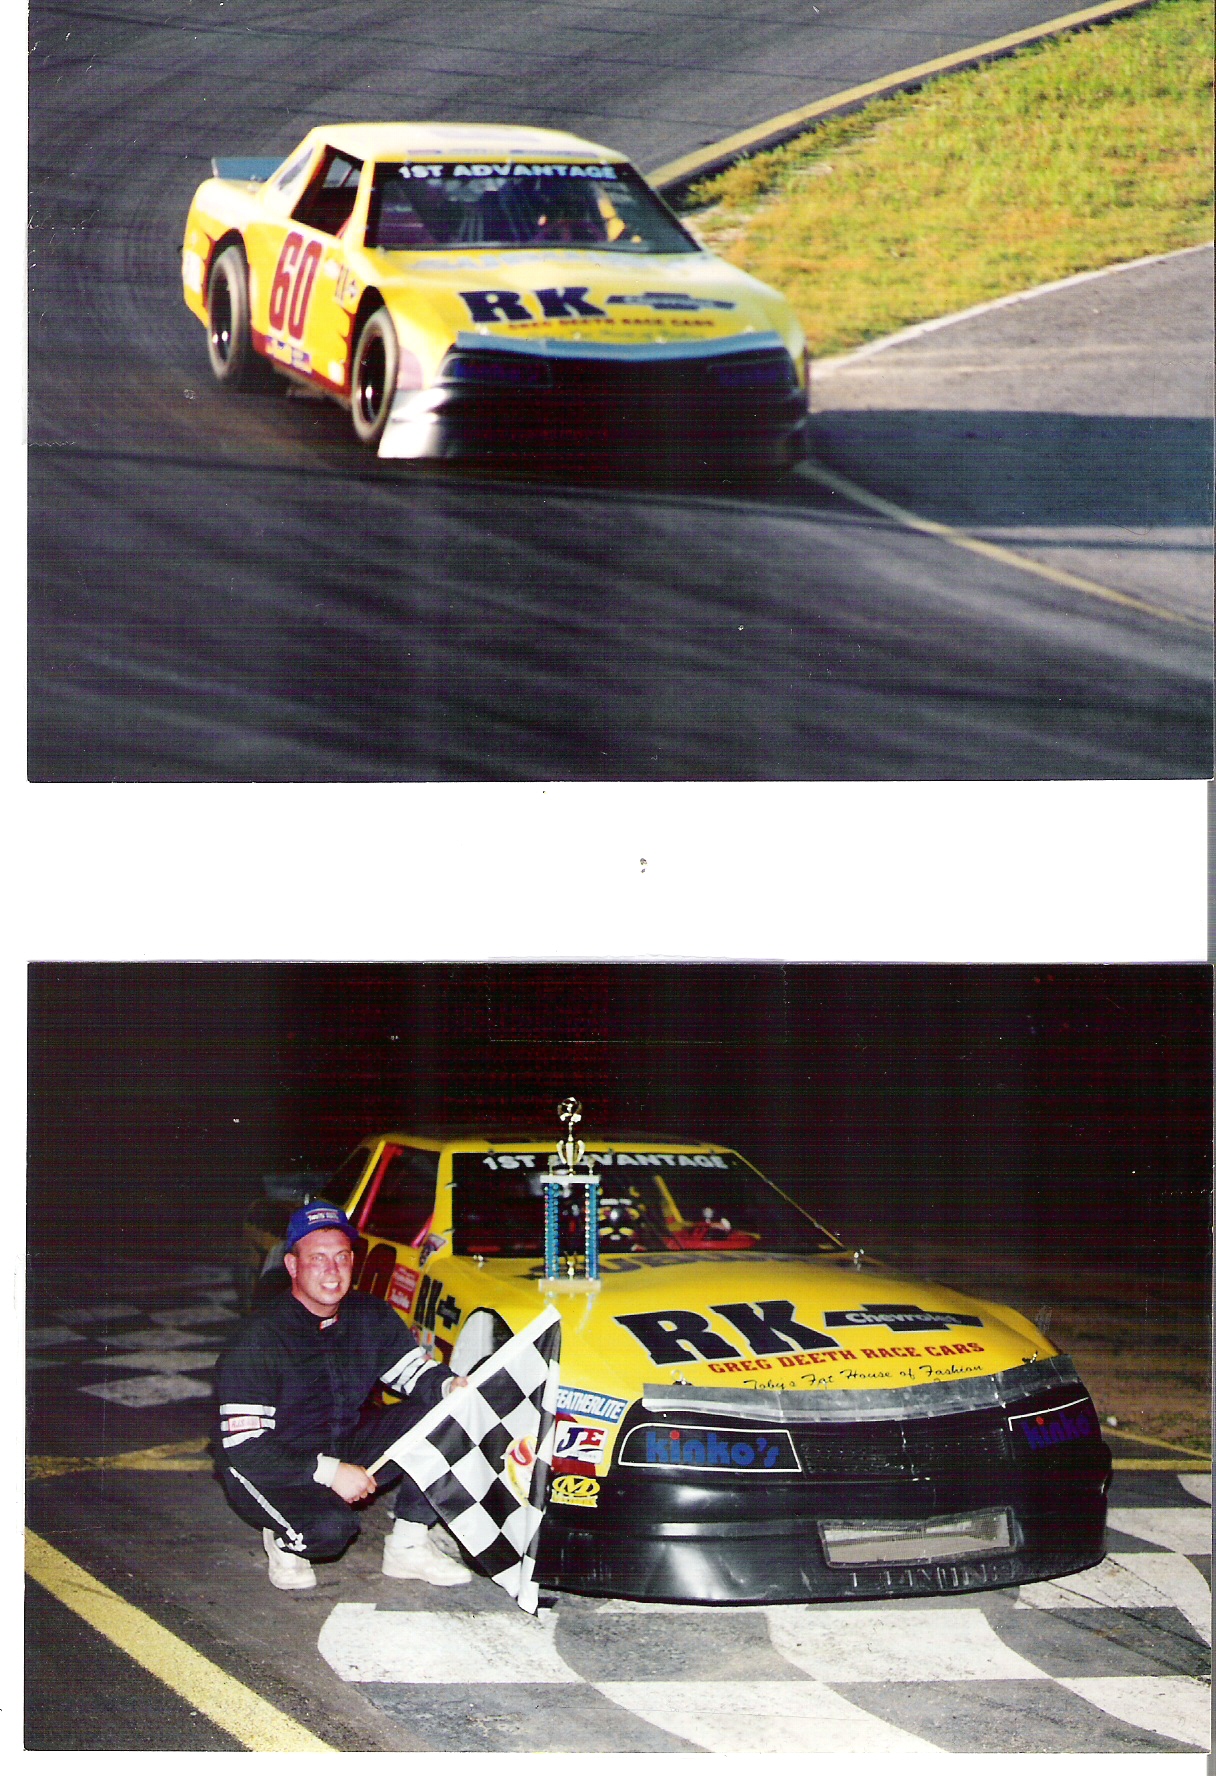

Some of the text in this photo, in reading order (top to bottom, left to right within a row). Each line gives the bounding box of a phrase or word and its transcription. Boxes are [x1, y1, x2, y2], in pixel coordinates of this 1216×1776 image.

[398, 164, 617, 180] 1ST ADVANTAGE
[268, 231, 322, 340] 60
[459, 287, 607, 323] RK
[483, 1156, 535, 1169] 1ST
[615, 1300, 840, 1366] RK
[845, 1312, 962, 1326] Chevrolet
[708, 1342, 985, 1374] GREG DEETH RACE CARS
[840, 1368, 893, 1381] House
[900, 1368, 917, 1379] of
[919, 1363, 984, 1378] Fashion
[557, 1427, 605, 1453] JE
[646, 1430, 780, 1468] kinko's
